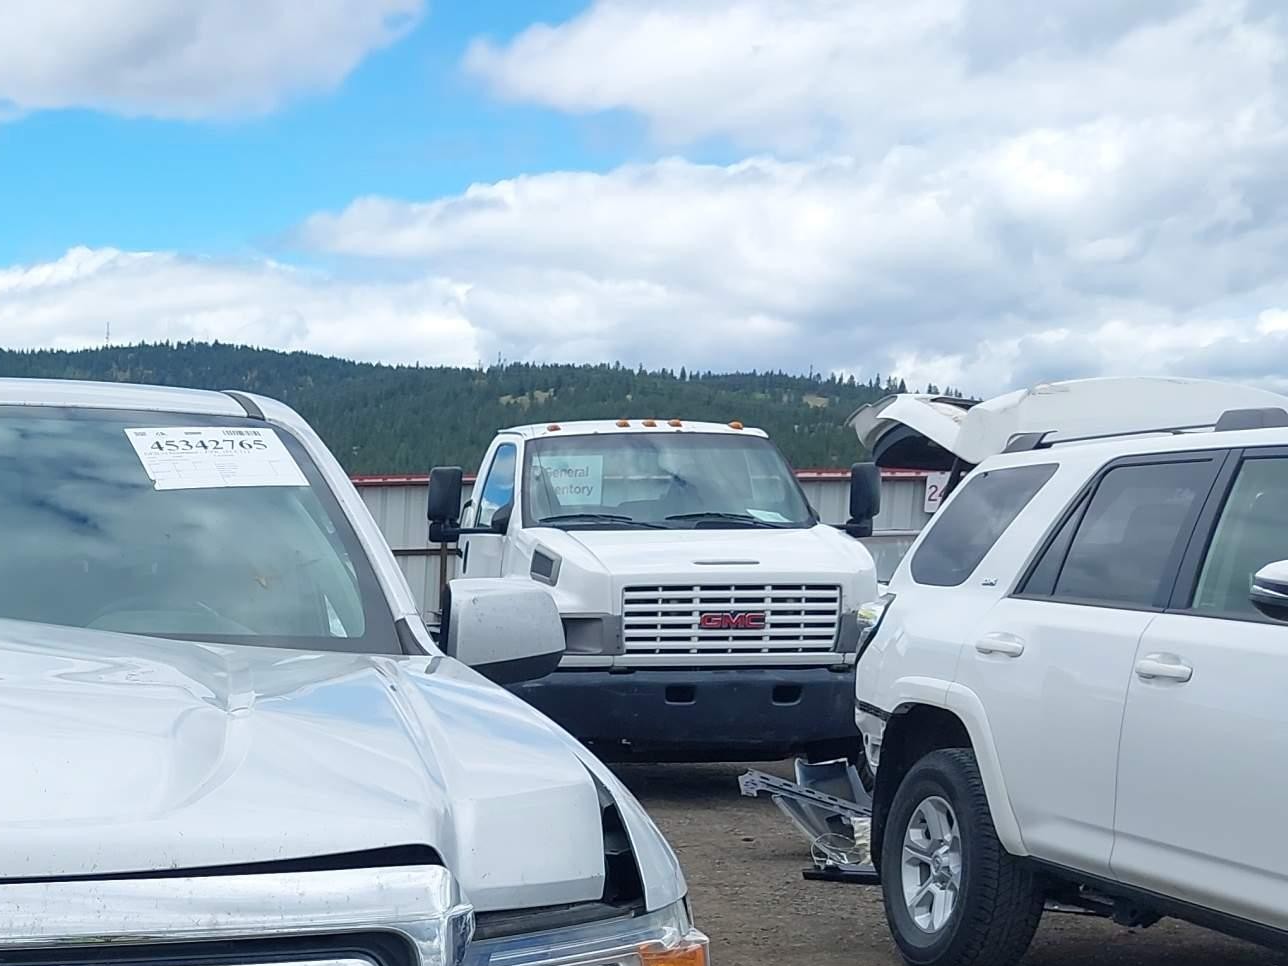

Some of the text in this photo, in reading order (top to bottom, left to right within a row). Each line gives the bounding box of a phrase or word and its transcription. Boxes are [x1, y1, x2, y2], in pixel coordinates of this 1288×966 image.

[150, 439, 268, 451] 45342765
[551, 484, 593, 497] entory
[700, 612, 766, 629] GMC
